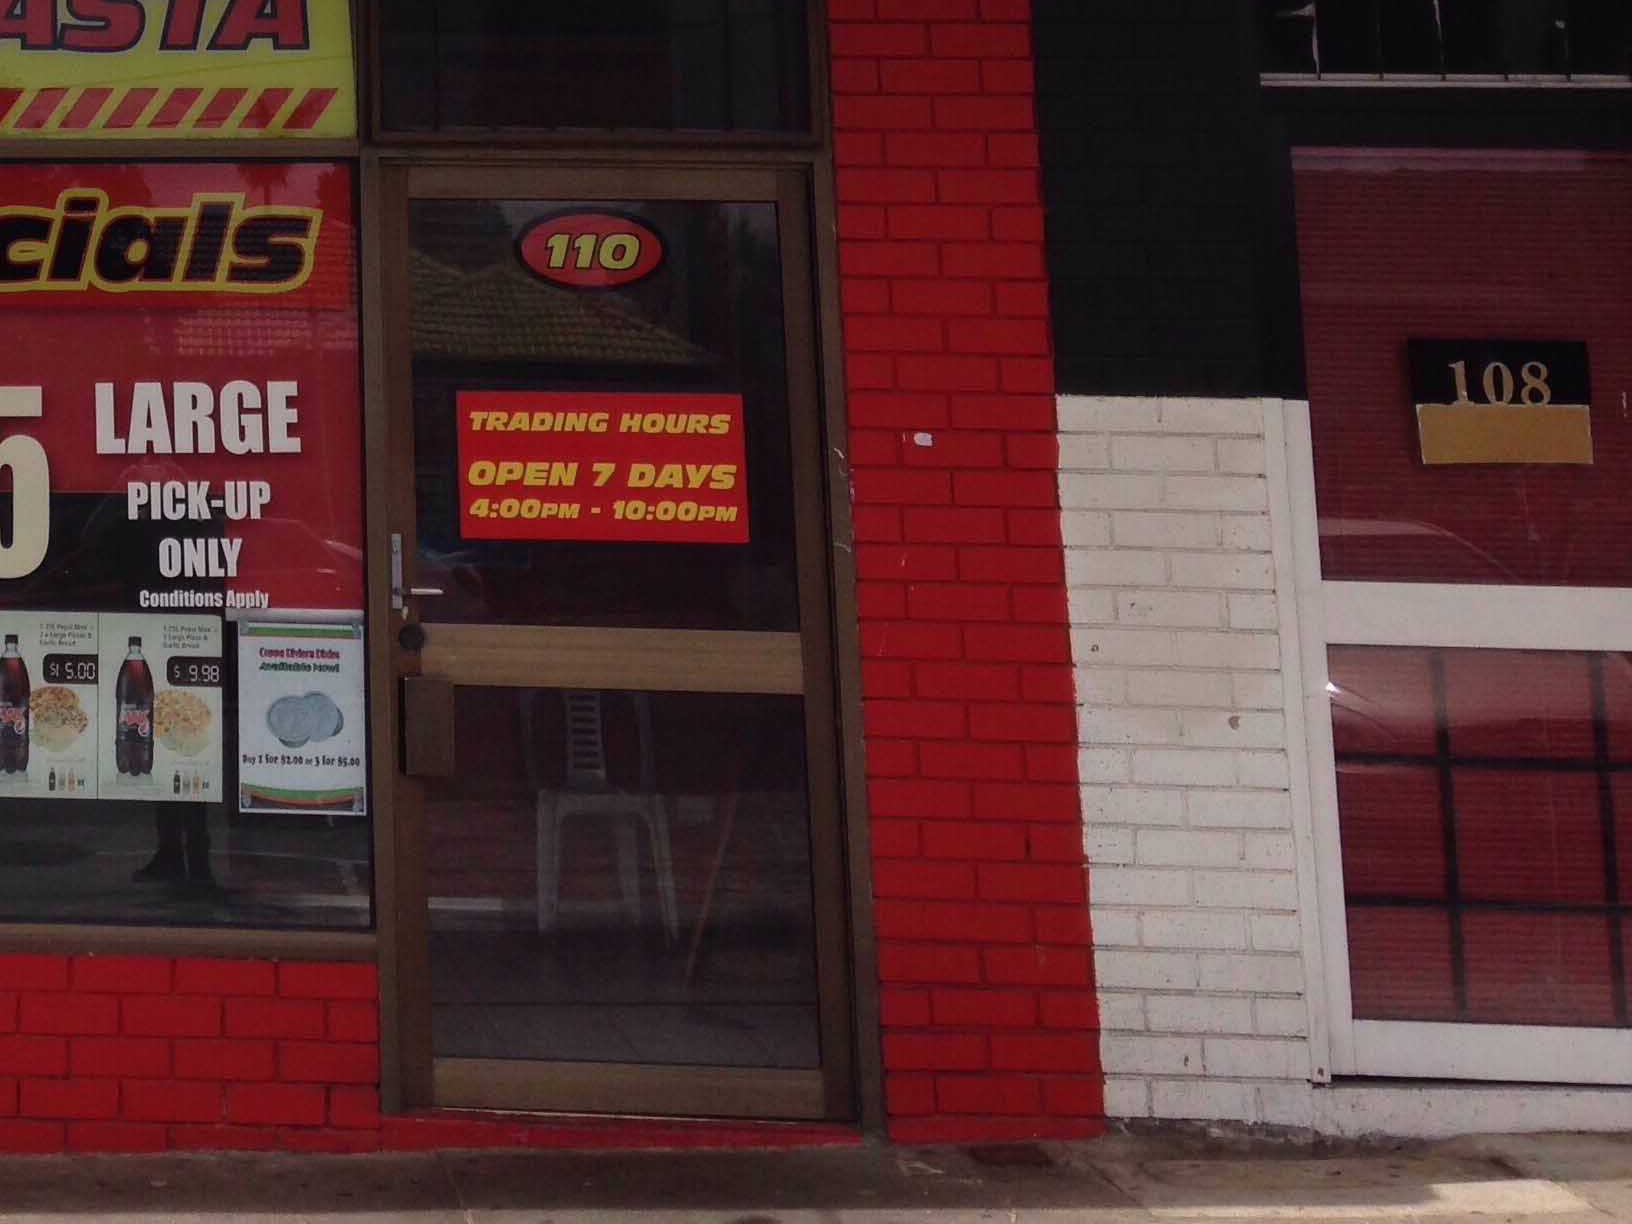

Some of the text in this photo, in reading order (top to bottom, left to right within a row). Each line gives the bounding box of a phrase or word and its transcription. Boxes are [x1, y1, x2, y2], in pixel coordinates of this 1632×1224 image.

[544, 232, 642, 270] 110
[1448, 360, 1552, 406] 108
[94, 380, 302, 455] LARGE
[469, 411, 731, 434] TRADING HOURS
[467, 460, 738, 490] OPEN 7 DAYS
[127, 481, 272, 521] PICK-UP
[469, 498, 581, 519] 4:00PM
[613, 500, 738, 521] 10:00PM
[158, 538, 242, 578] ONLY
[139, 589, 269, 609] Conditions Apply
[242, 754, 256, 766] Buy
[281, 754, 304, 765] $2.00
[337, 756, 360, 768] $5.00
